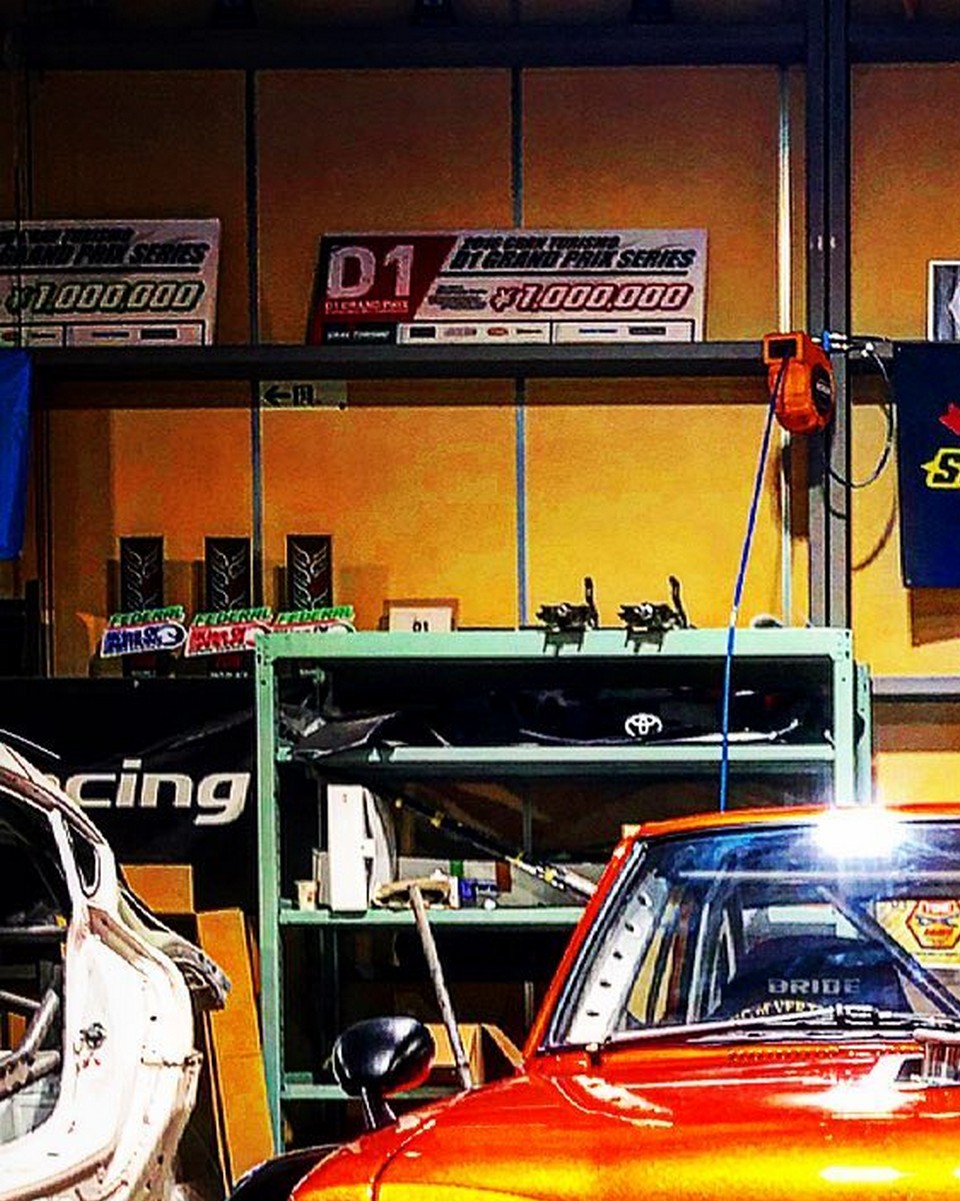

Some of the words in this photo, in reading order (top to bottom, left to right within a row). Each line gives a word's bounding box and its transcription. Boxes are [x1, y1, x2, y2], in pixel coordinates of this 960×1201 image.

[482, 250, 560, 269] GRAND
[560, 249, 617, 269] PRIX
[617, 248, 697, 269] SERIES
[326, 244, 415, 298] D1
[110, 605, 184, 626] FEDERAL
[45, 758, 251, 826] cing
[767, 978, 861, 995] BRIDE
